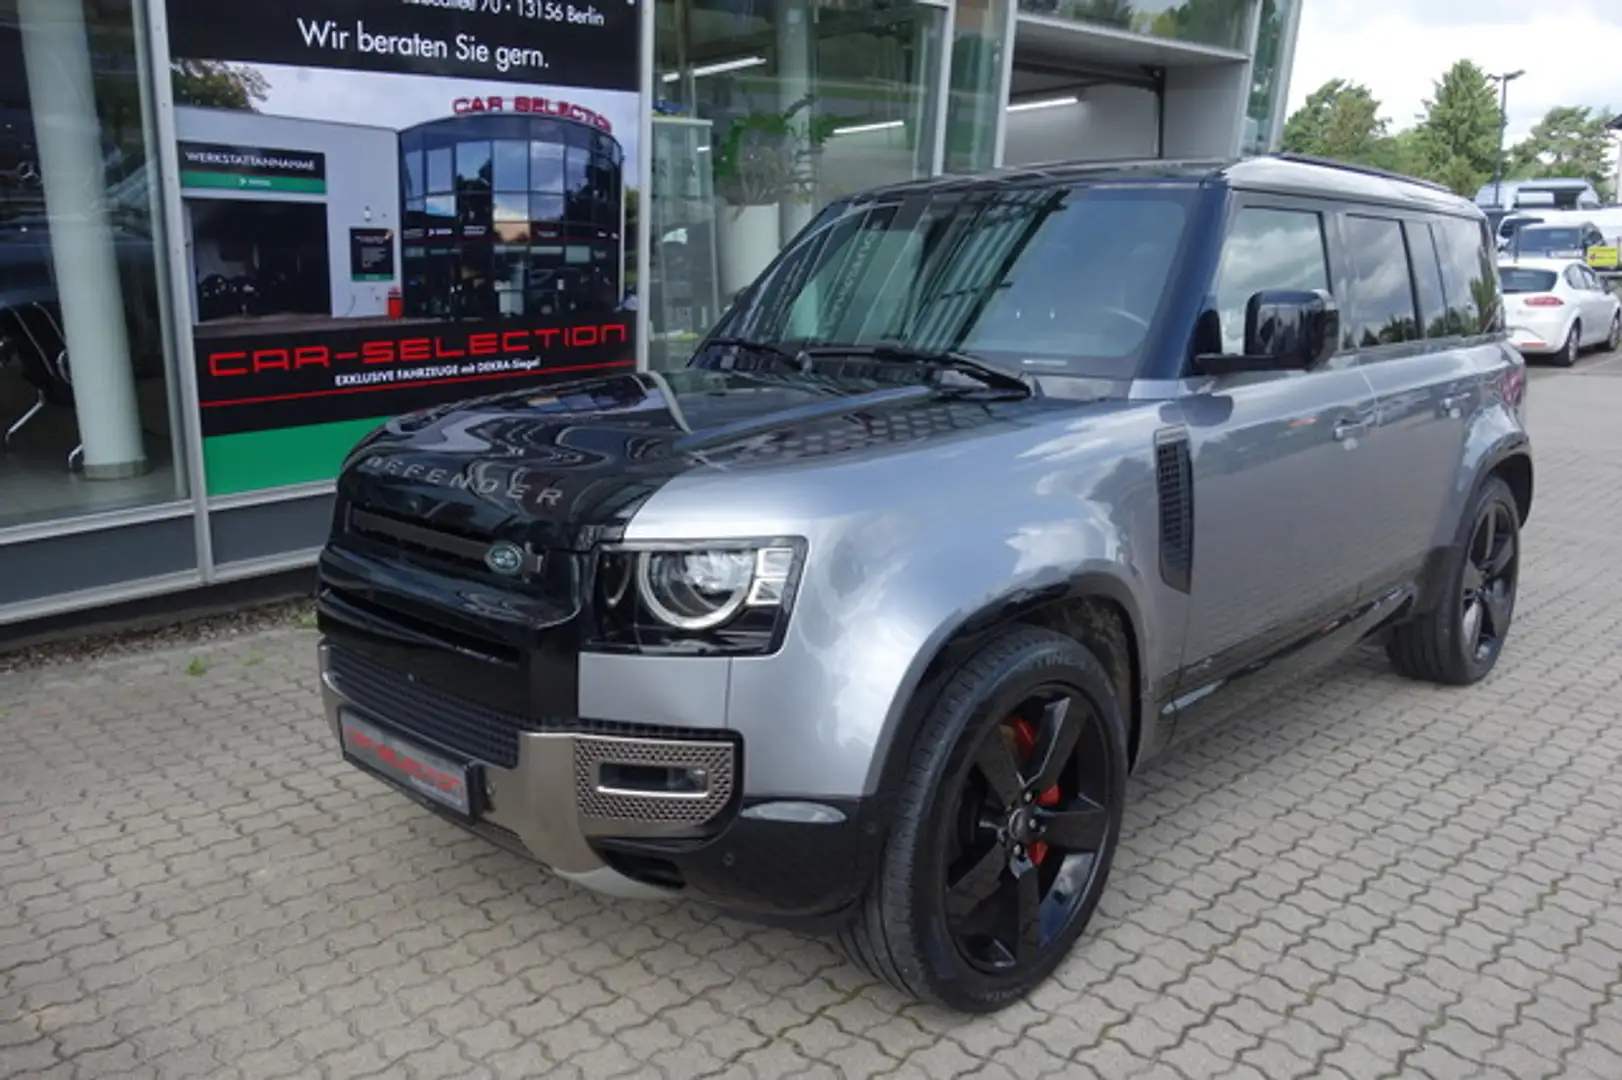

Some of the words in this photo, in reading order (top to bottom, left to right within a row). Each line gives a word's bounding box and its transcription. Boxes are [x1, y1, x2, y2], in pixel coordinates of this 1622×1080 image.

[517, 0, 564, 22] 13156
[566, 4, 605, 26] Berlin
[297, 17, 349, 50] Wir
[357, 20, 448, 58] beraten
[455, 33, 489, 62] Sie
[495, 45, 550, 72] gern.
[452, 96, 503, 114] CAR
[208, 323, 627, 377] CAR-SELECTION
[334, 369, 395, 387] EXKLUSIVE
[397, 364, 459, 381] FAHRZEUGE
